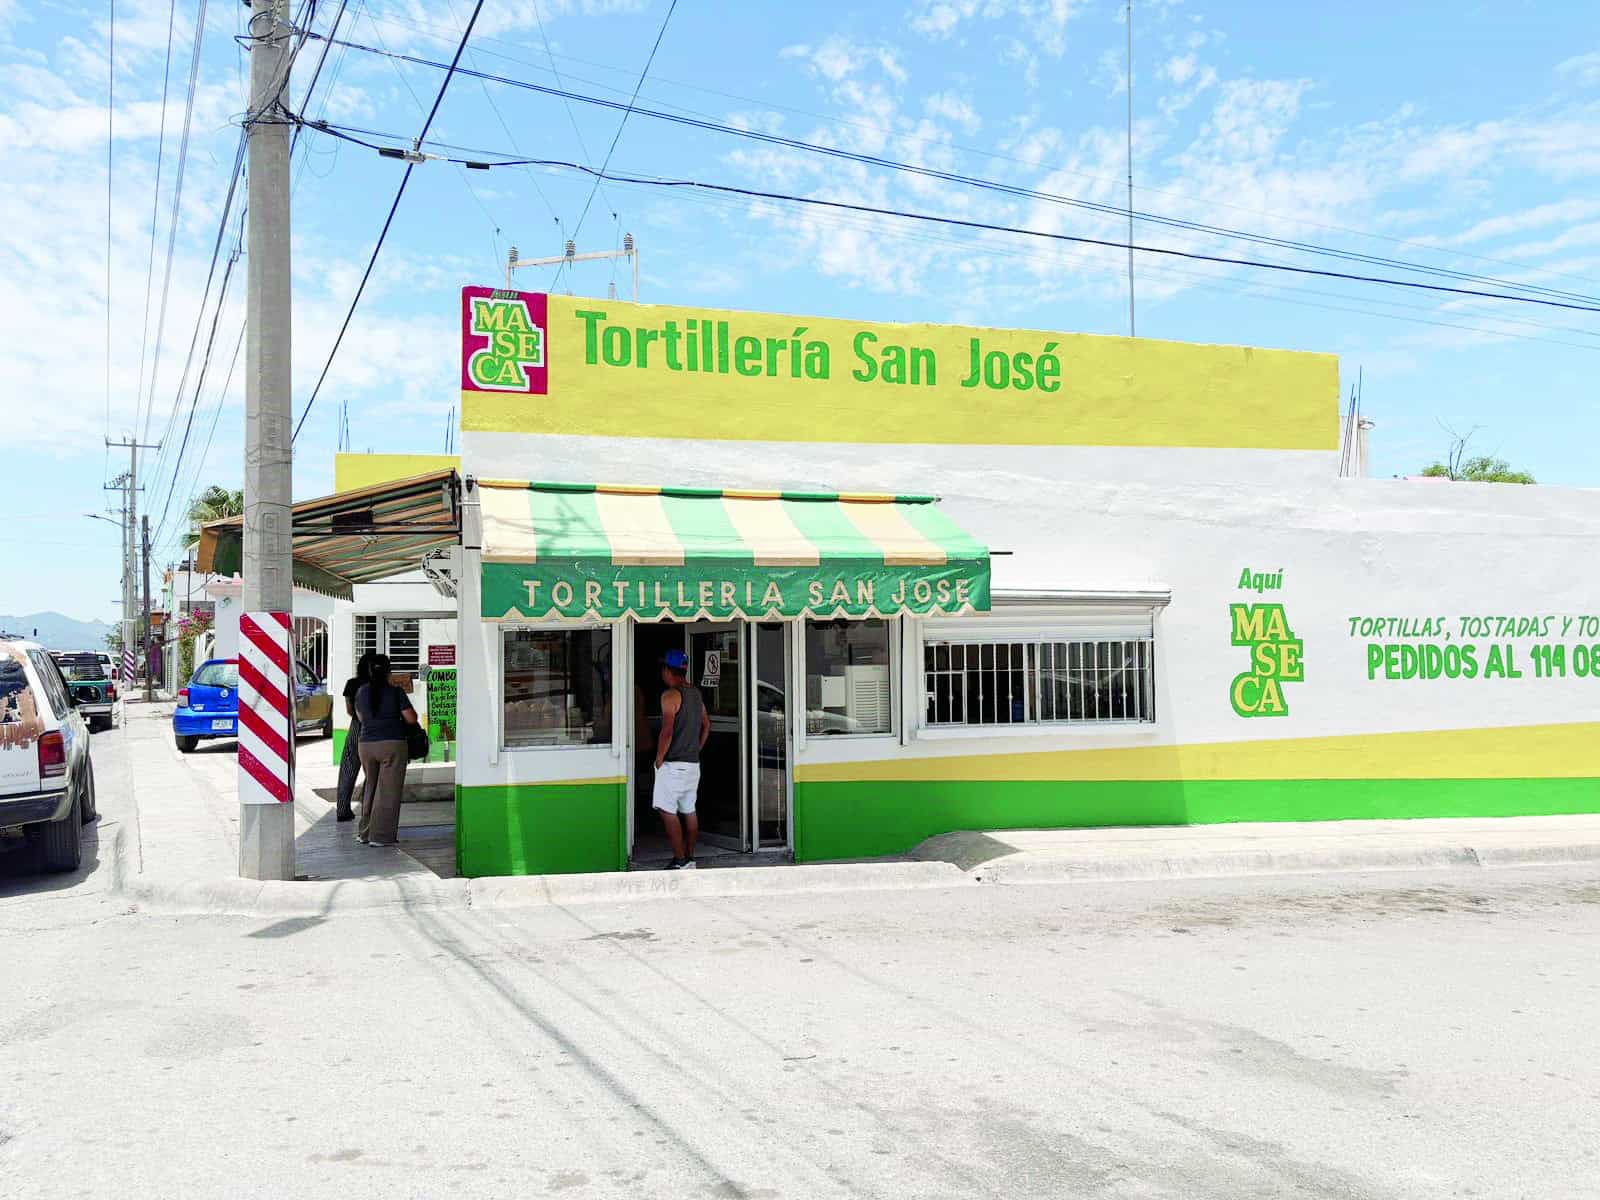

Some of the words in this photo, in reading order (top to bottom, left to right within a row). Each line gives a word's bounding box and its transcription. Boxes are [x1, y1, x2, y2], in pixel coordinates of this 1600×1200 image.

[576, 311, 831, 380] Tortillería
[853, 332, 937, 386] San
[961, 339, 1062, 393] José
[522, 578, 785, 608] TORTILLERIA
[808, 579, 875, 605] SAN
[891, 578, 969, 604] JOSE
[1238, 567, 1283, 593] Aquí
[1348, 616, 1451, 641] TORTILLAS,
[1460, 615, 1555, 638] TOSTADAS
[1561, 615, 1573, 637] Y
[1367, 643, 1479, 680] PEDIDOS
[1484, 644, 1522, 679] AL
[1530, 644, 1566, 678] 114
